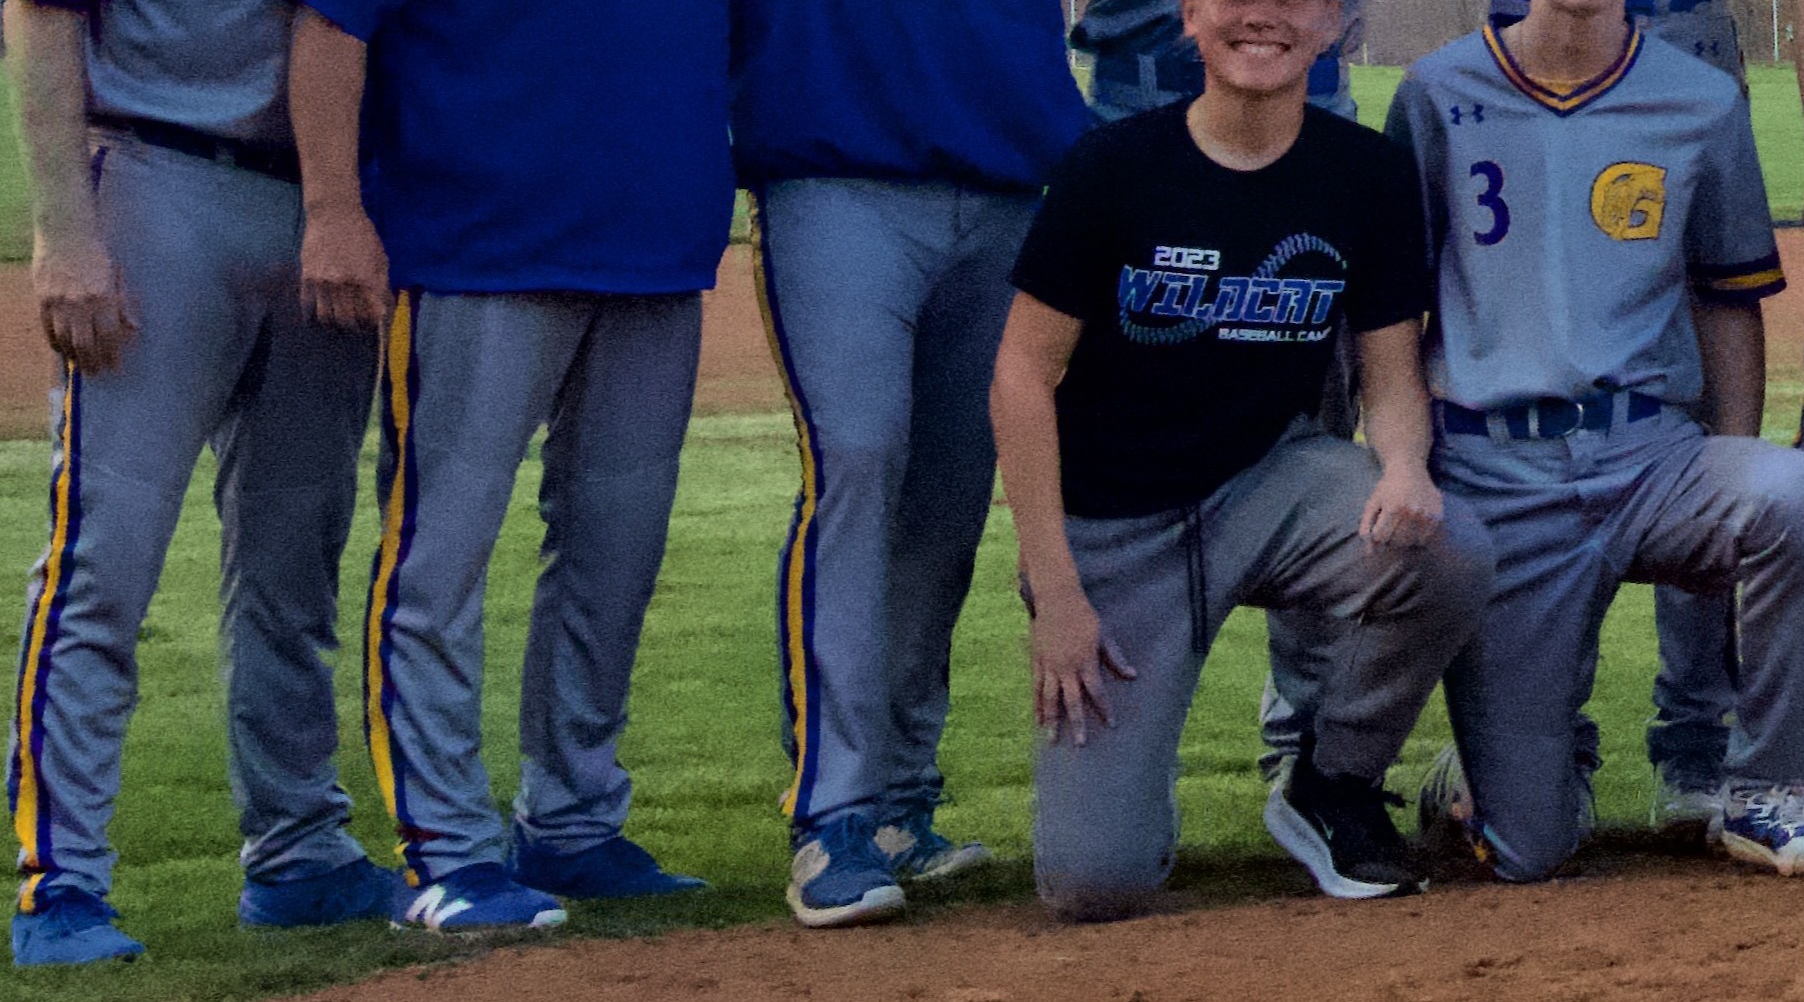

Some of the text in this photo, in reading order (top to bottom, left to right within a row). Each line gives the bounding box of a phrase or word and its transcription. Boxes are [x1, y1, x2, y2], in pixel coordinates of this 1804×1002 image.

[1469, 160, 1511, 247] 3
[1154, 246, 1221, 271] 2023
[1118, 264, 1346, 324] WILDCAT
[1218, 328, 1293, 342] BASEBALL
